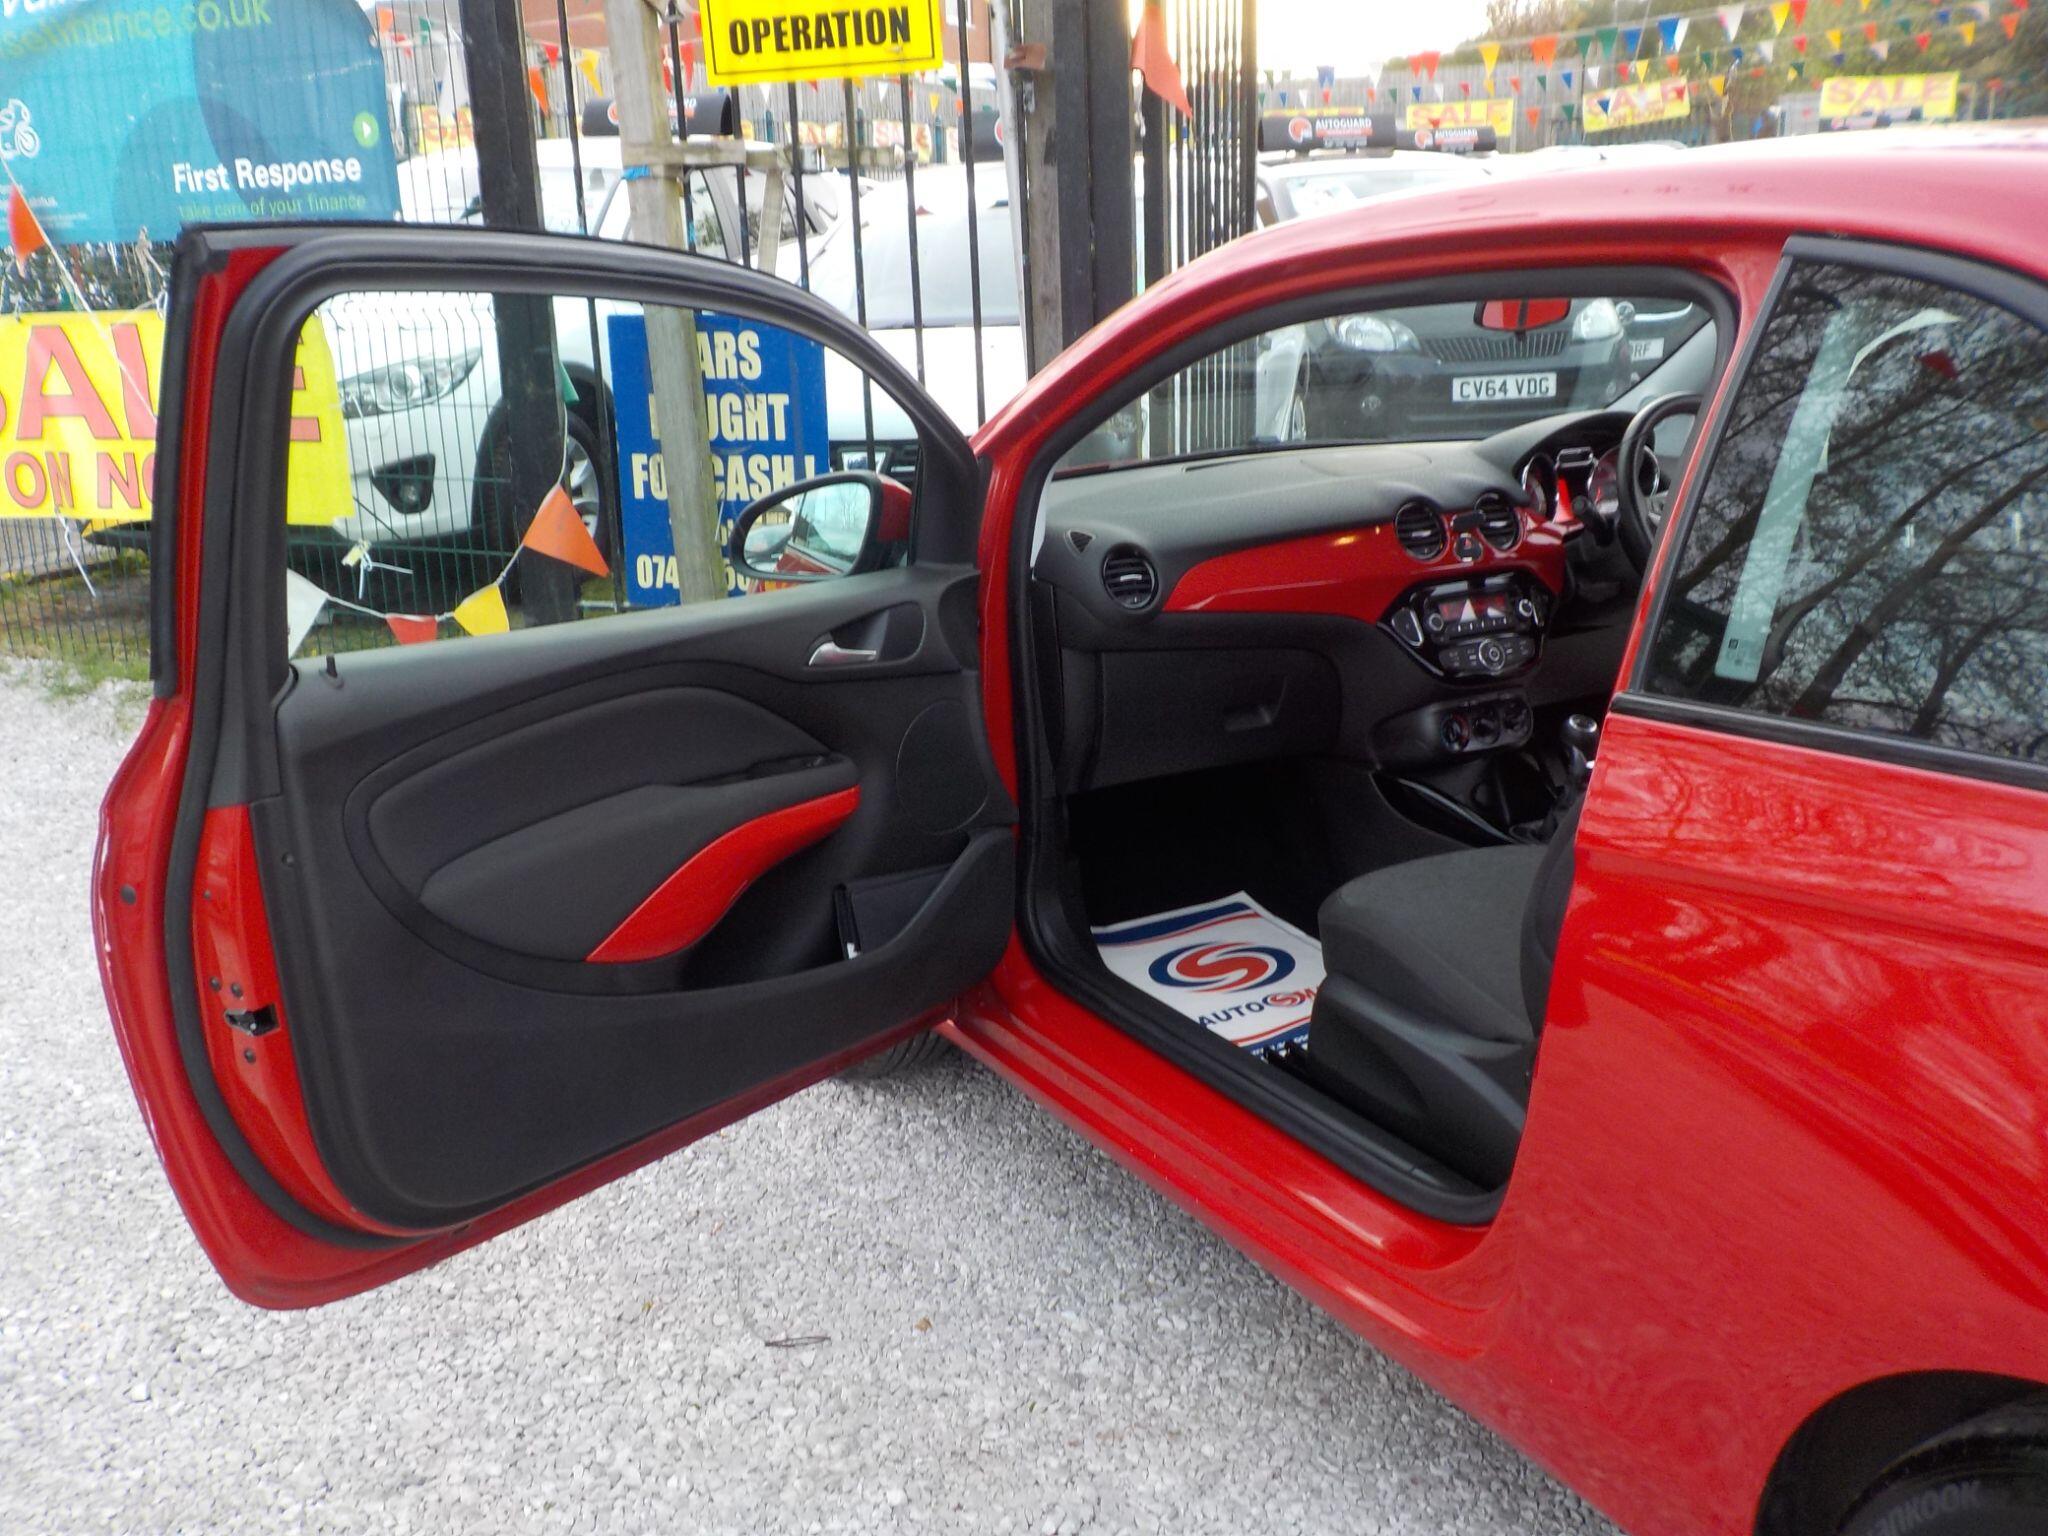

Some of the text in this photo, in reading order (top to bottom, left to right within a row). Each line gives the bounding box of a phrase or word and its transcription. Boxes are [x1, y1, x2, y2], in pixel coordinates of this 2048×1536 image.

[728, 5, 911, 56] OPERATION
[1315, 117, 1373, 129] AUTOGUARD
[172, 157, 361, 194] First Response
[250, 197, 264, 213] of
[269, 199, 303, 217] your
[307, 192, 365, 212] finance
[696, 330, 762, 380] ARS
[1459, 379, 1509, 399] CV64
[648, 391, 790, 442] UGHT
[4, 451, 75, 509] ON
[631, 452, 670, 500] FO
